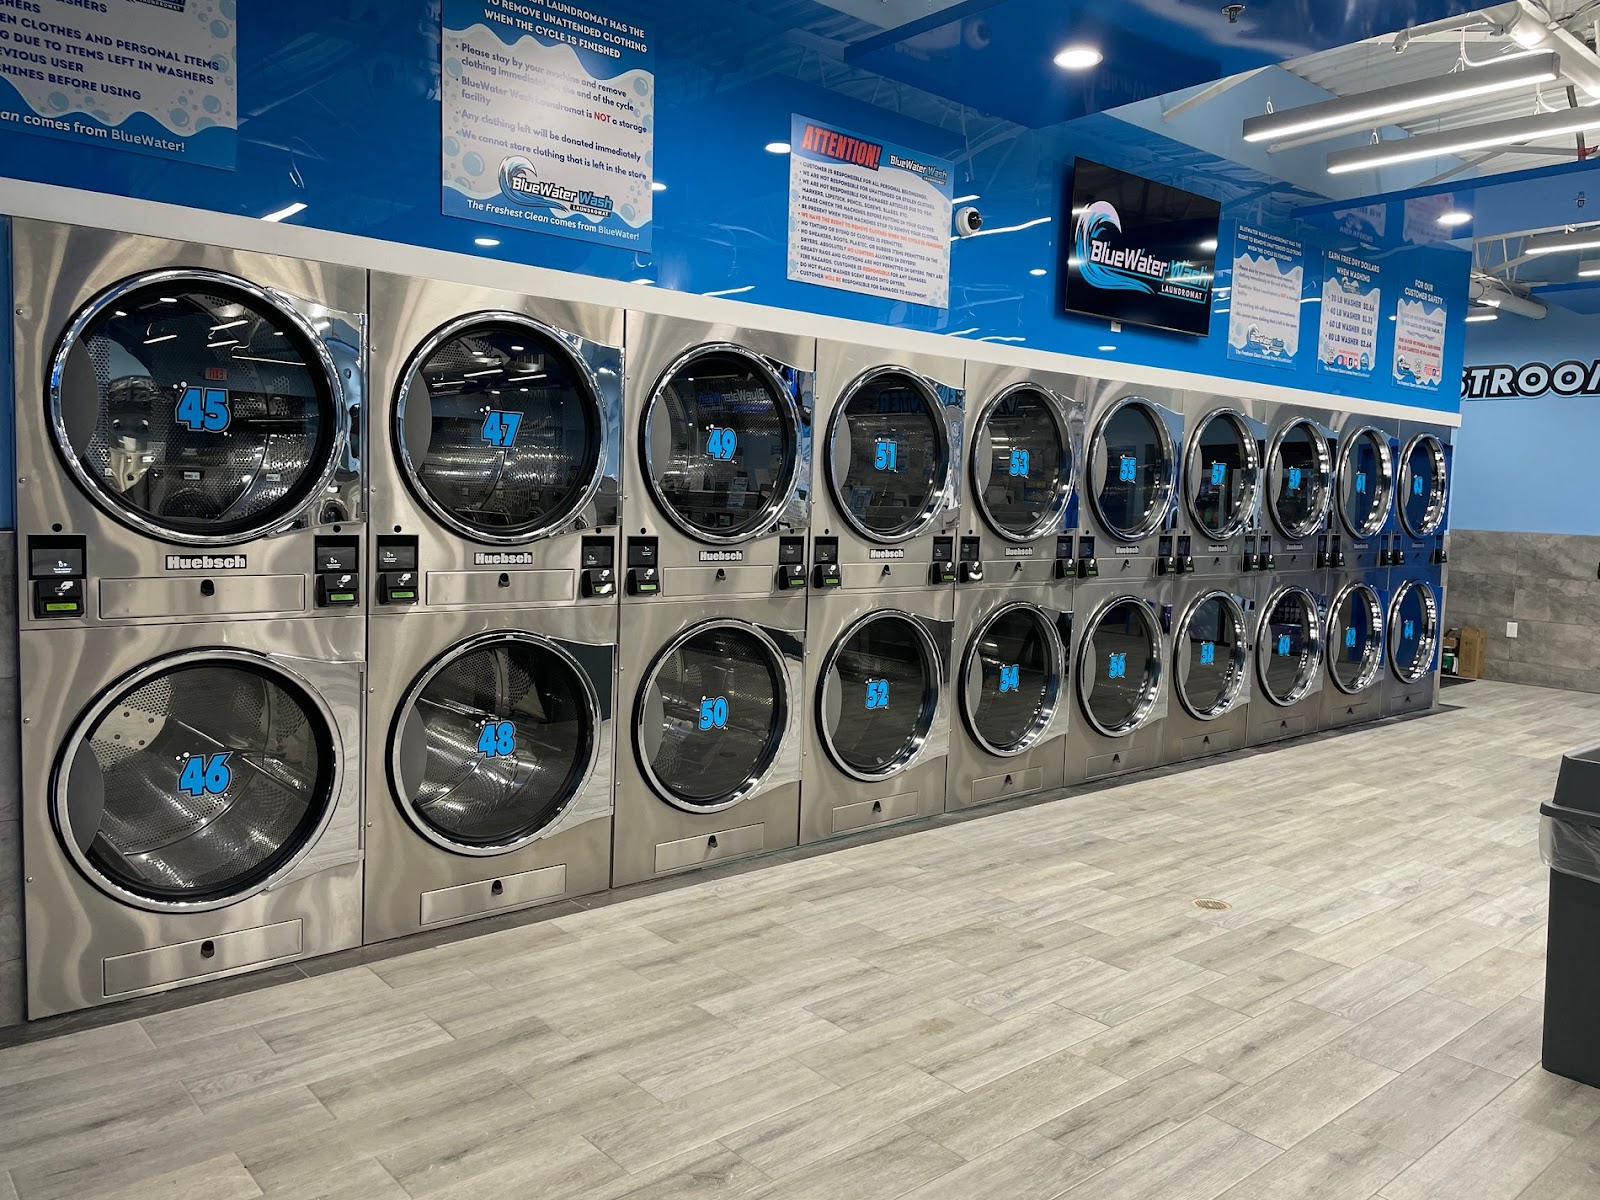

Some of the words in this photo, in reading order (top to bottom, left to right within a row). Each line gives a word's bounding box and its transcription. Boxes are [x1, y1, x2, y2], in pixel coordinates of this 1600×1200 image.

[0, 0, 40, 13] HERS
[56, 0, 107, 12] HERS
[546, 0, 608, 26] LAUNDROMAT
[610, 19, 627, 32] HAS
[629, 26, 644, 38] THE
[484, 8, 513, 25] WHEN
[516, 18, 533, 31] THE
[535, 25, 565, 41] CYCLE
[567, 35, 577, 45] IS
[579, 38, 621, 58] FINISHED
[502, 0, 541, 19] REMOVE
[543, 12, 601, 37] UNATTENDED
[603, 32, 647, 52] CLOTHING
[21, 18, 81, 39] CLOTHES
[85, 33, 112, 46] AND
[116, 39, 180, 62] PERSONAL
[184, 55, 219, 70] ITEMS
[14, 32, 40, 47] DUE
[44, 39, 61, 51] TO
[66, 44, 104, 60] ITEMS
[108, 53, 135, 66] LEFT
[138, 60, 152, 71] IN
[156, 63, 214, 84] WASHERS
[51, 57, 84, 72] USER
[461, 57, 496, 75] clothing
[462, 42, 490, 58] Please
[492, 53, 510, 65] stay
[512, 57, 523, 69] by
[525, 62, 545, 74] your
[582, 79, 597, 89] and
[598, 84, 626, 97] remove
[0, 64, 44, 80] HINES
[48, 73, 97, 91] BEFORE
[101, 84, 141, 100] USING
[462, 89, 490, 106] facility
[462, 76, 507, 95] BlueWater
[510, 89, 533, 102] Wash
[586, 109, 592, 118] is
[593, 111, 611, 123] NOT
[619, 120, 647, 133] storage
[577, 91, 591, 100] end
[593, 93, 601, 102] of
[602, 96, 614, 106] the
[616, 101, 634, 111] cycle
[23, 115, 70, 131] comes
[74, 122, 107, 137] from
[111, 129, 185, 152] BlueWater!
[461, 109, 479, 122] Any
[482, 115, 515, 132] clothing
[518, 122, 531, 134] left
[533, 129, 547, 137] will
[550, 130, 559, 140] be
[561, 134, 593, 149] donated
[595, 143, 641, 162] immediately
[802, 124, 881, 169] ATTENTION!
[461, 128, 476, 140] We
[478, 135, 508, 148] cannot
[510, 143, 531, 152] store
[533, 146, 565, 162] clothing
[567, 154, 583, 165] that
[584, 158, 590, 167] is
[592, 159, 605, 170] left
[606, 163, 613, 172] in
[615, 165, 627, 175] the
[628, 170, 647, 180] store
[890, 155, 927, 173] BlueWater
[928, 166, 947, 179] Wash
[511, 177, 577, 201] BlueWater
[578, 190, 613, 209] Wash
[467, 199, 484, 210] The
[486, 204, 522, 217] Freshest
[524, 211, 549, 222] Clean
[550, 216, 577, 229] comes
[578, 221, 597, 233] from
[598, 226, 640, 240] BlueWater!
[832, 267, 851, 276] WASHER
[1090, 239, 1168, 277] BlueWater
[1170, 260, 1208, 284] Wash
[1328, 250, 1340, 261] EARN
[1341, 255, 1351, 265] FREE
[1361, 261, 1380, 273] DOLLARS
[800, 270, 824, 279] CUSTOMER
[842, 277, 870, 288] RESPONSIBLE
[1161, 284, 1202, 300] LAUNDROMAT
[1343, 298, 1361, 309] WASHER
[1343, 310, 1360, 321] WASHER
[1341, 335, 1359, 346] WASHER
[1342, 322, 1360, 333] WASHER
[175, 387, 231, 433] 45
[481, 410, 524, 449] 47
[706, 427, 737, 461] 49
[874, 441, 897, 470] 51
[1009, 450, 1029, 477] 53
[1119, 457, 1137, 482] 55
[1211, 463, 1227, 485] 57
[166, 556, 246, 569] Huebsch
[475, 553, 532, 564] Huebsch
[700, 551, 742, 561] Huebsch
[870, 549, 904, 558] Huebsch
[1109, 653, 1127, 678] 56
[1201, 642, 1215, 665] 58
[999, 664, 1020, 692] 54
[865, 679, 889, 709] 52
[699, 695, 729, 730] 50
[477, 719, 516, 758] 48
[178, 751, 233, 796] 46
